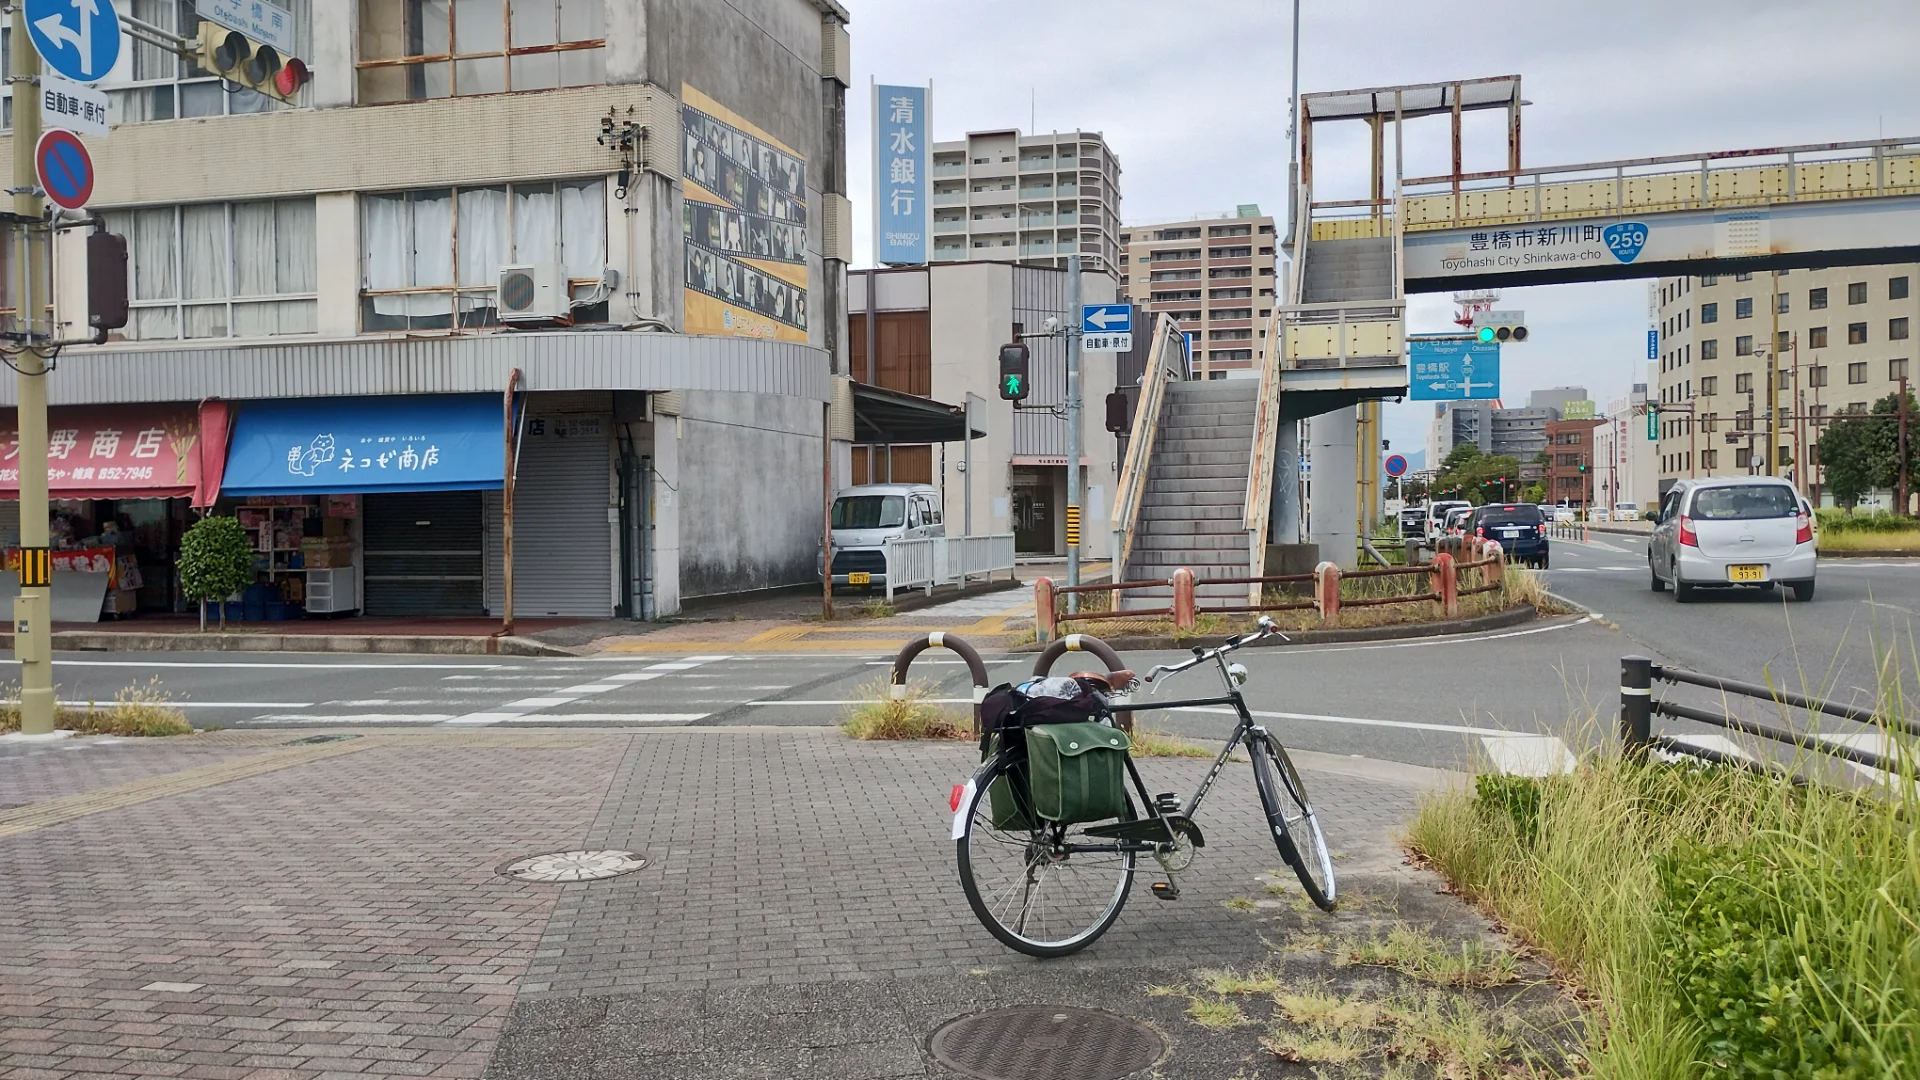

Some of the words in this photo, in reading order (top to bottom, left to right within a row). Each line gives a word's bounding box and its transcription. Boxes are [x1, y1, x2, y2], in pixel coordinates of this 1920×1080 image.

[219, 0, 283, 31] 手橋南
[889, 96, 915, 216] 清水銀行
[885, 232, 920, 241] SHIMIZU
[1469, 225, 1603, 251] 豊橋市新川町
[1609, 231, 1645, 249] 259
[1440, 256, 1495, 271] Toyohashi
[1498, 254, 1520, 267] City
[1523, 249, 1601, 264] Shinkawa-cho
[1416, 362, 1450, 373] 豊橋駅
[338, 444, 440, 473] ネコゼ商店
